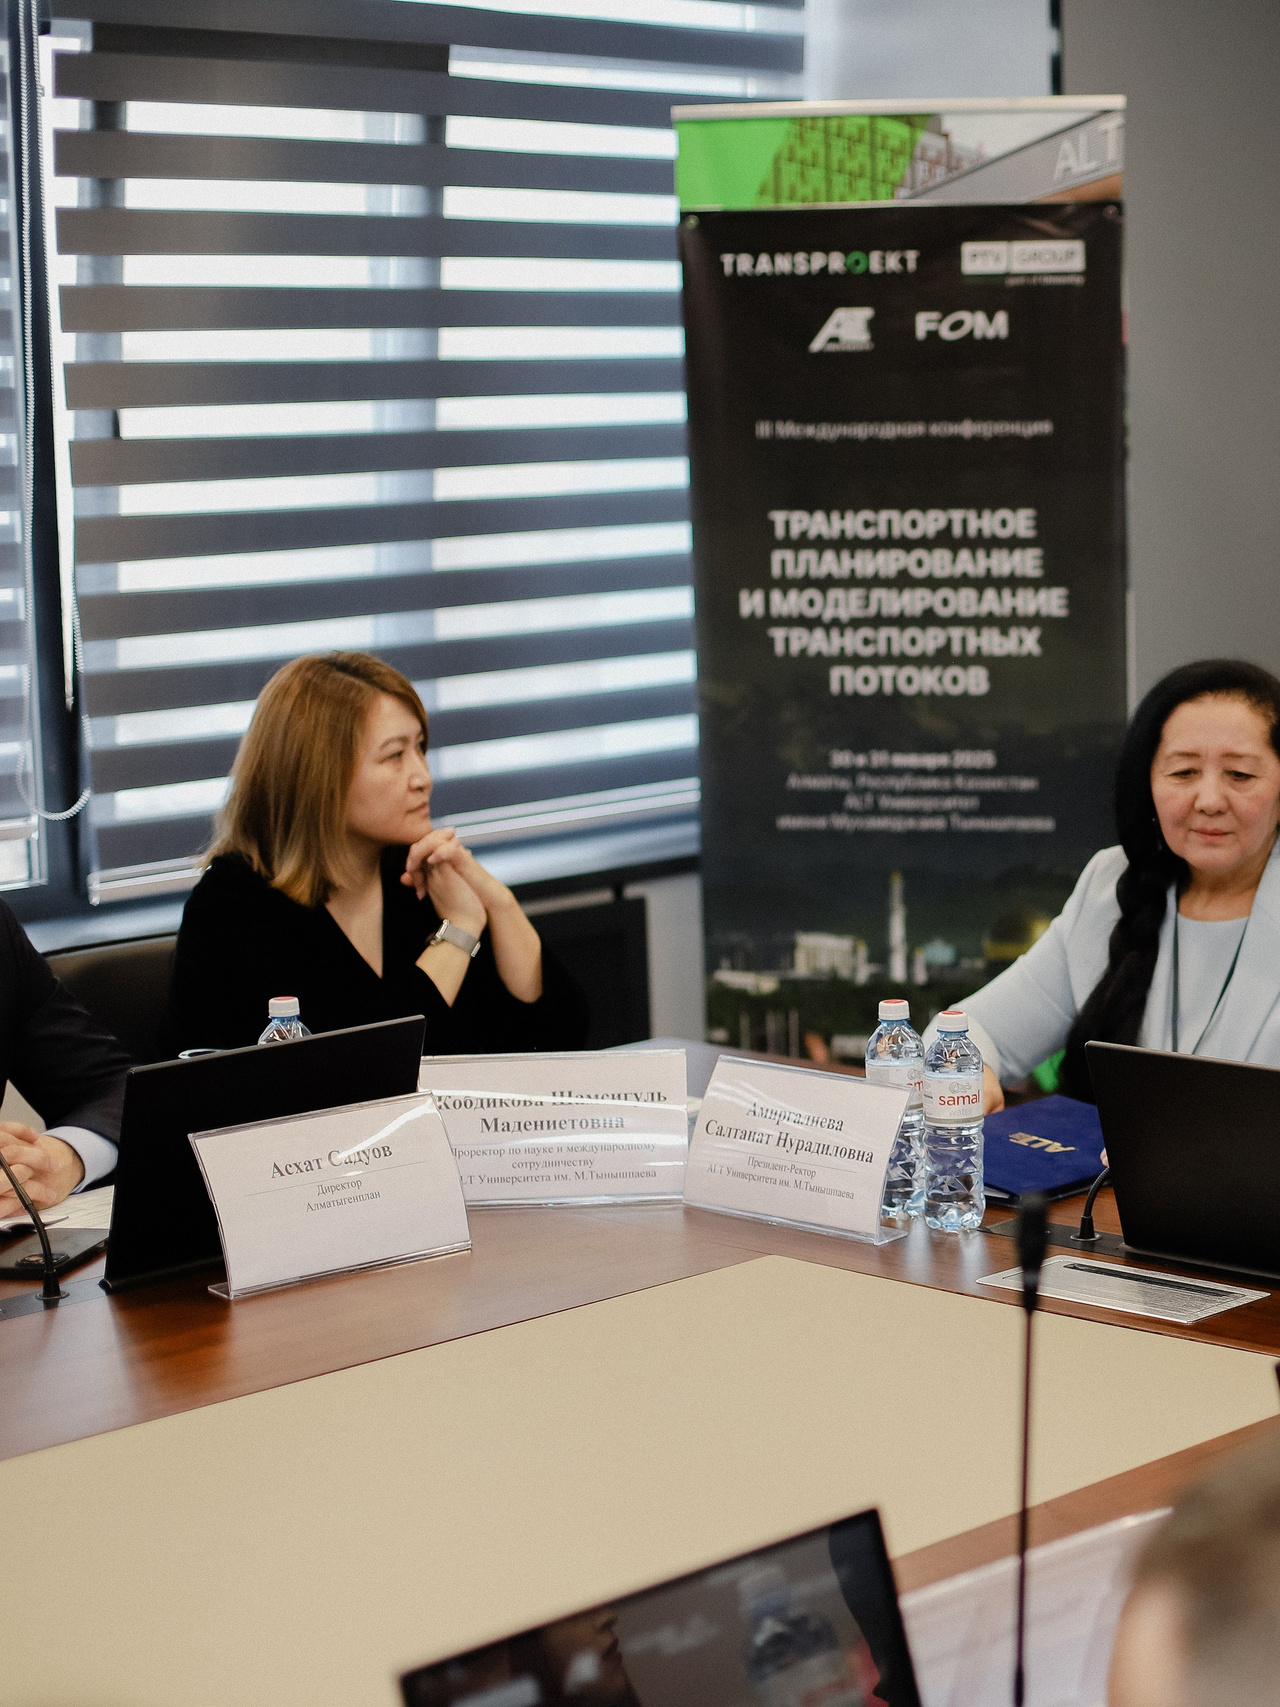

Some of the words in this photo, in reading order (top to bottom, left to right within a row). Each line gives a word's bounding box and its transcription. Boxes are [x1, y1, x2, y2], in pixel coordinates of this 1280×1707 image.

[721, 249, 920, 276] TRANSPROEKT
[914, 310, 1009, 341] FOM
[768, 508, 1038, 540] ТРАНСПОРТНОЕ
[770, 547, 1045, 579] ПЛАНИРОВАНИЕ
[738, 588, 765, 618] И
[769, 586, 1069, 624] МОДЕЛИРОВАНИЕ
[767, 626, 1042, 657] ТРАНСПОРТНЫХ
[829, 665, 990, 697] ПОТОКОВ
[939, 1090, 980, 1106] samal
[746, 1102, 844, 1132] Амиргалиева
[948, 1107, 973, 1117] water
[479, 1116, 625, 1134] Мадениетовна
[508, 1147, 522, 1155] по
[524, 1145, 554, 1156] науке
[556, 1146, 564, 1154] и
[566, 1143, 656, 1155] международному
[705, 1119, 773, 1145] Салтанат
[775, 1131, 874, 1164] Нурадиловна
[270, 1154, 323, 1179] Асхат
[327, 1144, 393, 1168] Садуов
[511, 1158, 595, 1170] сотрудничеству
[747, 1156, 817, 1179] Президент-Ректор
[317, 1178, 363, 1198] Директор
[459, 1175, 475, 1186] LT
[478, 1173, 552, 1185] Университета
[553, 1172, 572, 1182] им.
[725, 1164, 777, 1185] Университета
[778, 1179, 791, 1188] им.
[305, 1189, 381, 1213] Алматыгенплан
